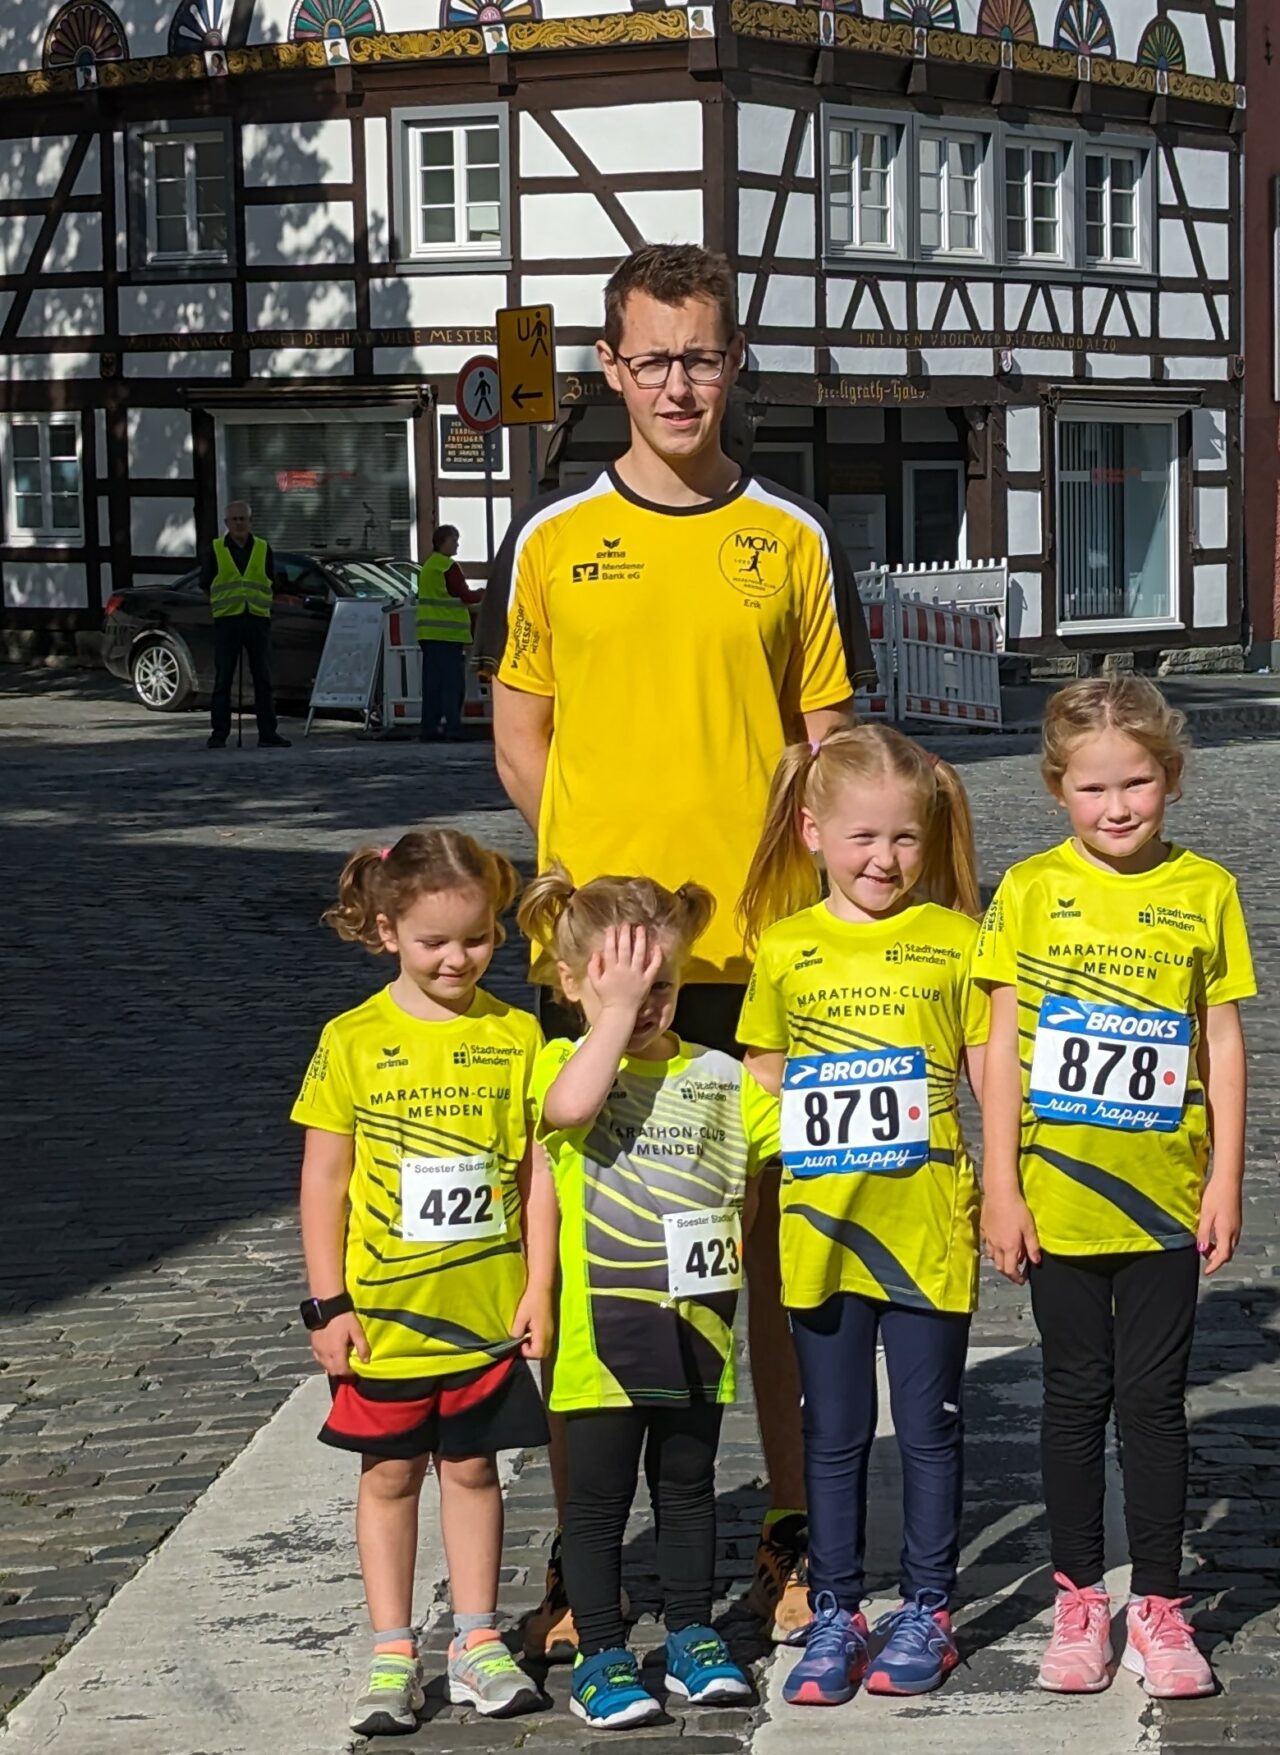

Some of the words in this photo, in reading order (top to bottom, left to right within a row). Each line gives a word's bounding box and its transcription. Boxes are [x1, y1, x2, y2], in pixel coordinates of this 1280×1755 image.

[430, 328, 498, 343] MESTER
[596, 549, 626, 558] erima
[601, 572, 625, 581] Bank
[628, 572, 641, 580] eG
[1050, 910, 1081, 919] erima
[1156, 916, 1195, 932] Menden
[904, 943, 962, 960] Stadtwerke
[1048, 945, 1195, 968] MARATHON-CLUB
[794, 957, 823, 971] erima
[904, 954, 946, 966] Menden
[1083, 962, 1158, 980] MENDEN
[797, 985, 941, 1007] MARATHON-CLUB
[827, 1003, 906, 1018] MENDEN
[1086, 1011, 1180, 1039] BROOKS
[470, 1044, 524, 1056] Stadtwerke
[376, 1057, 409, 1070] erima
[471, 1055, 510, 1066] Menden
[819, 1055, 914, 1082] BROOKS
[1058, 1037, 1159, 1102] 878
[694, 1081, 741, 1093] Stadtwerke
[370, 1086, 512, 1105] MARATHON-CLUB
[696, 1090, 727, 1101] Menden
[408, 1104, 483, 1118] MENDEN
[804, 1086, 900, 1147] 879
[1047, 1097, 1088, 1115] run
[1091, 1101, 1164, 1128] happy
[610, 1121, 727, 1142] ARATHON-CLUB
[636, 1143, 704, 1156] MENDEN
[802, 1152, 837, 1168] run
[842, 1148, 912, 1173] happy
[414, 1163, 455, 1174] Soester
[419, 1184, 494, 1226] 422
[676, 1216, 709, 1228] Soester
[685, 1237, 740, 1279] 423
